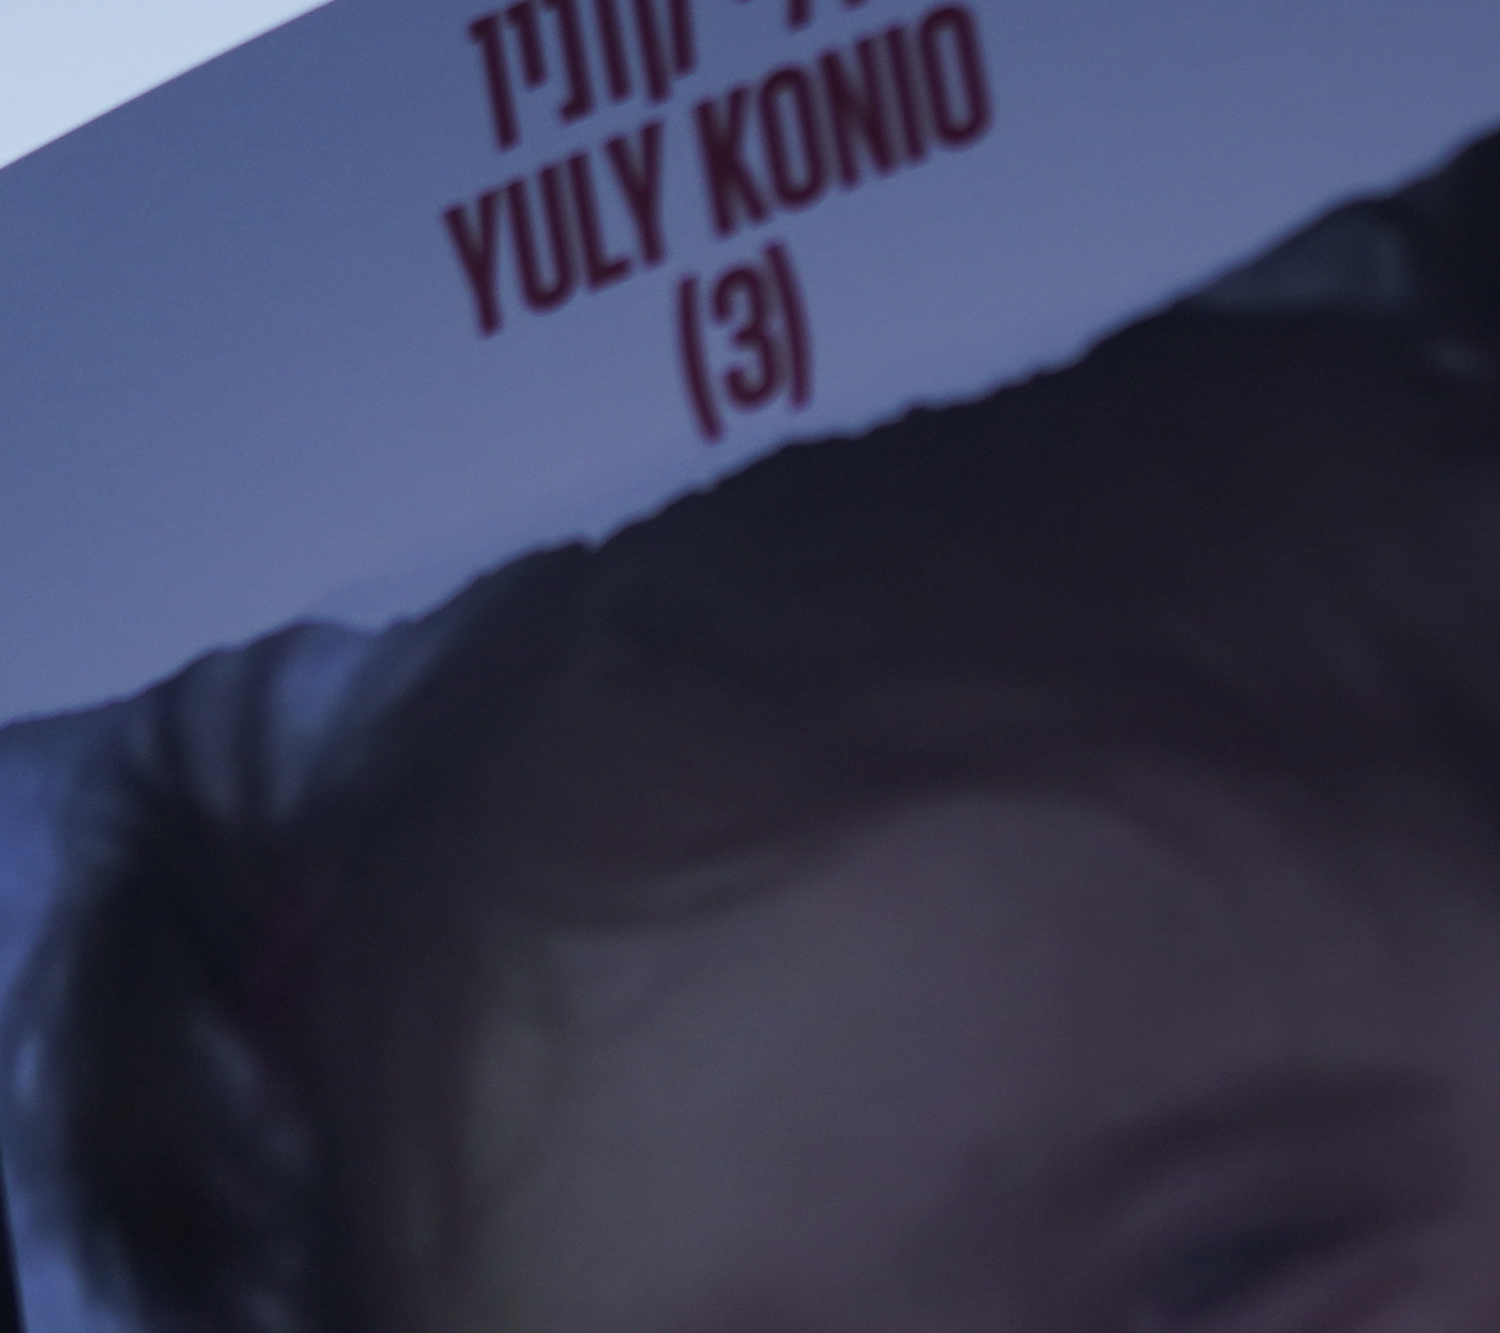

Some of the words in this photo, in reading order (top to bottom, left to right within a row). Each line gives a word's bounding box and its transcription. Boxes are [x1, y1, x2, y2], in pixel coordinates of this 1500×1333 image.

[443, 118, 666, 338] YULY
[693, 3, 995, 240] KONIO
[676, 240, 816, 443] (3)
